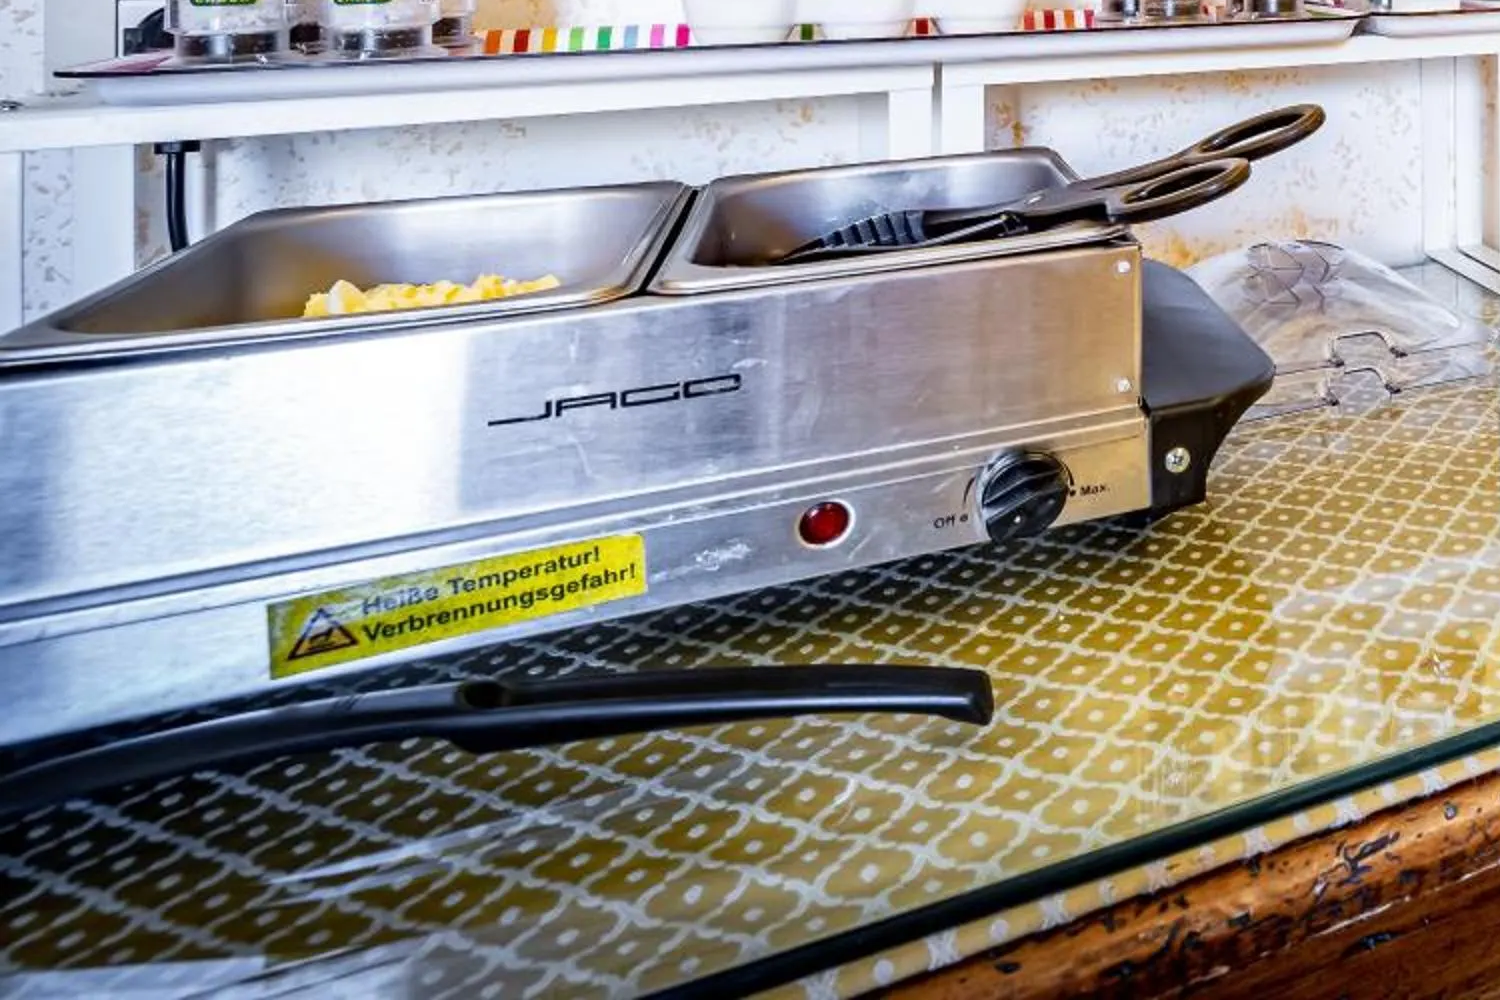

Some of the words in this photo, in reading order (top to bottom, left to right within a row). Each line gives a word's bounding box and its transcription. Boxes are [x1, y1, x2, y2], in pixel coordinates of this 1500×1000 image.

[934, 516, 955, 529] Off
[361, 583, 440, 616] Heiße
[447, 546, 600, 597] Temperatur!
[362, 563, 636, 643] Verbrennungsgefahr!
